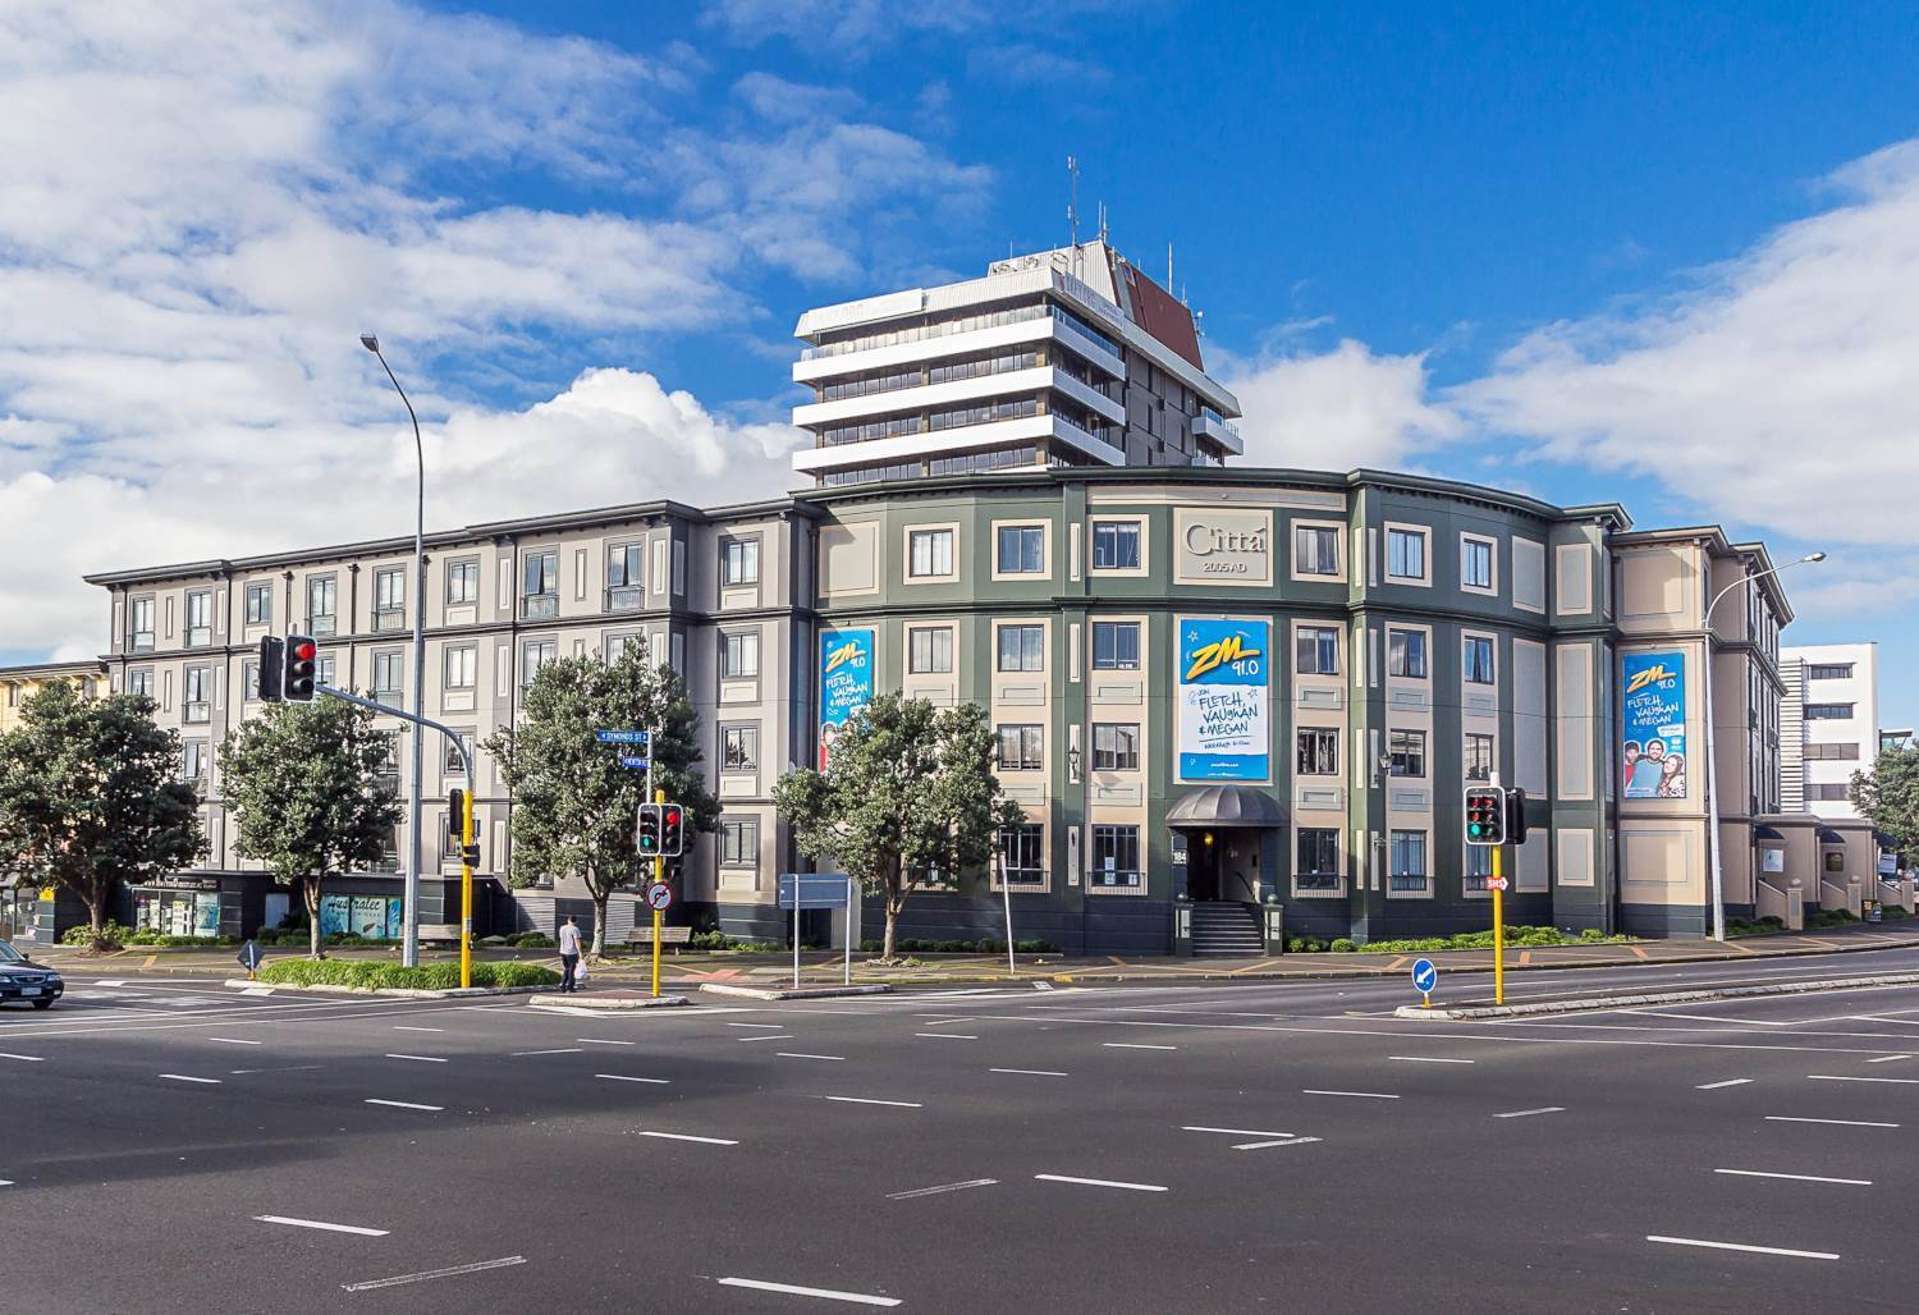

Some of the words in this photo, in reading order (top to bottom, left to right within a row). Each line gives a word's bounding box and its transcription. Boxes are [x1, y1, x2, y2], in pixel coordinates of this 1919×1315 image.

[826, 641, 866, 672] ZM
[1186, 635, 1260, 680] ZM
[1232, 660, 1259, 676] 91.0
[1627, 665, 1677, 693] ZM
